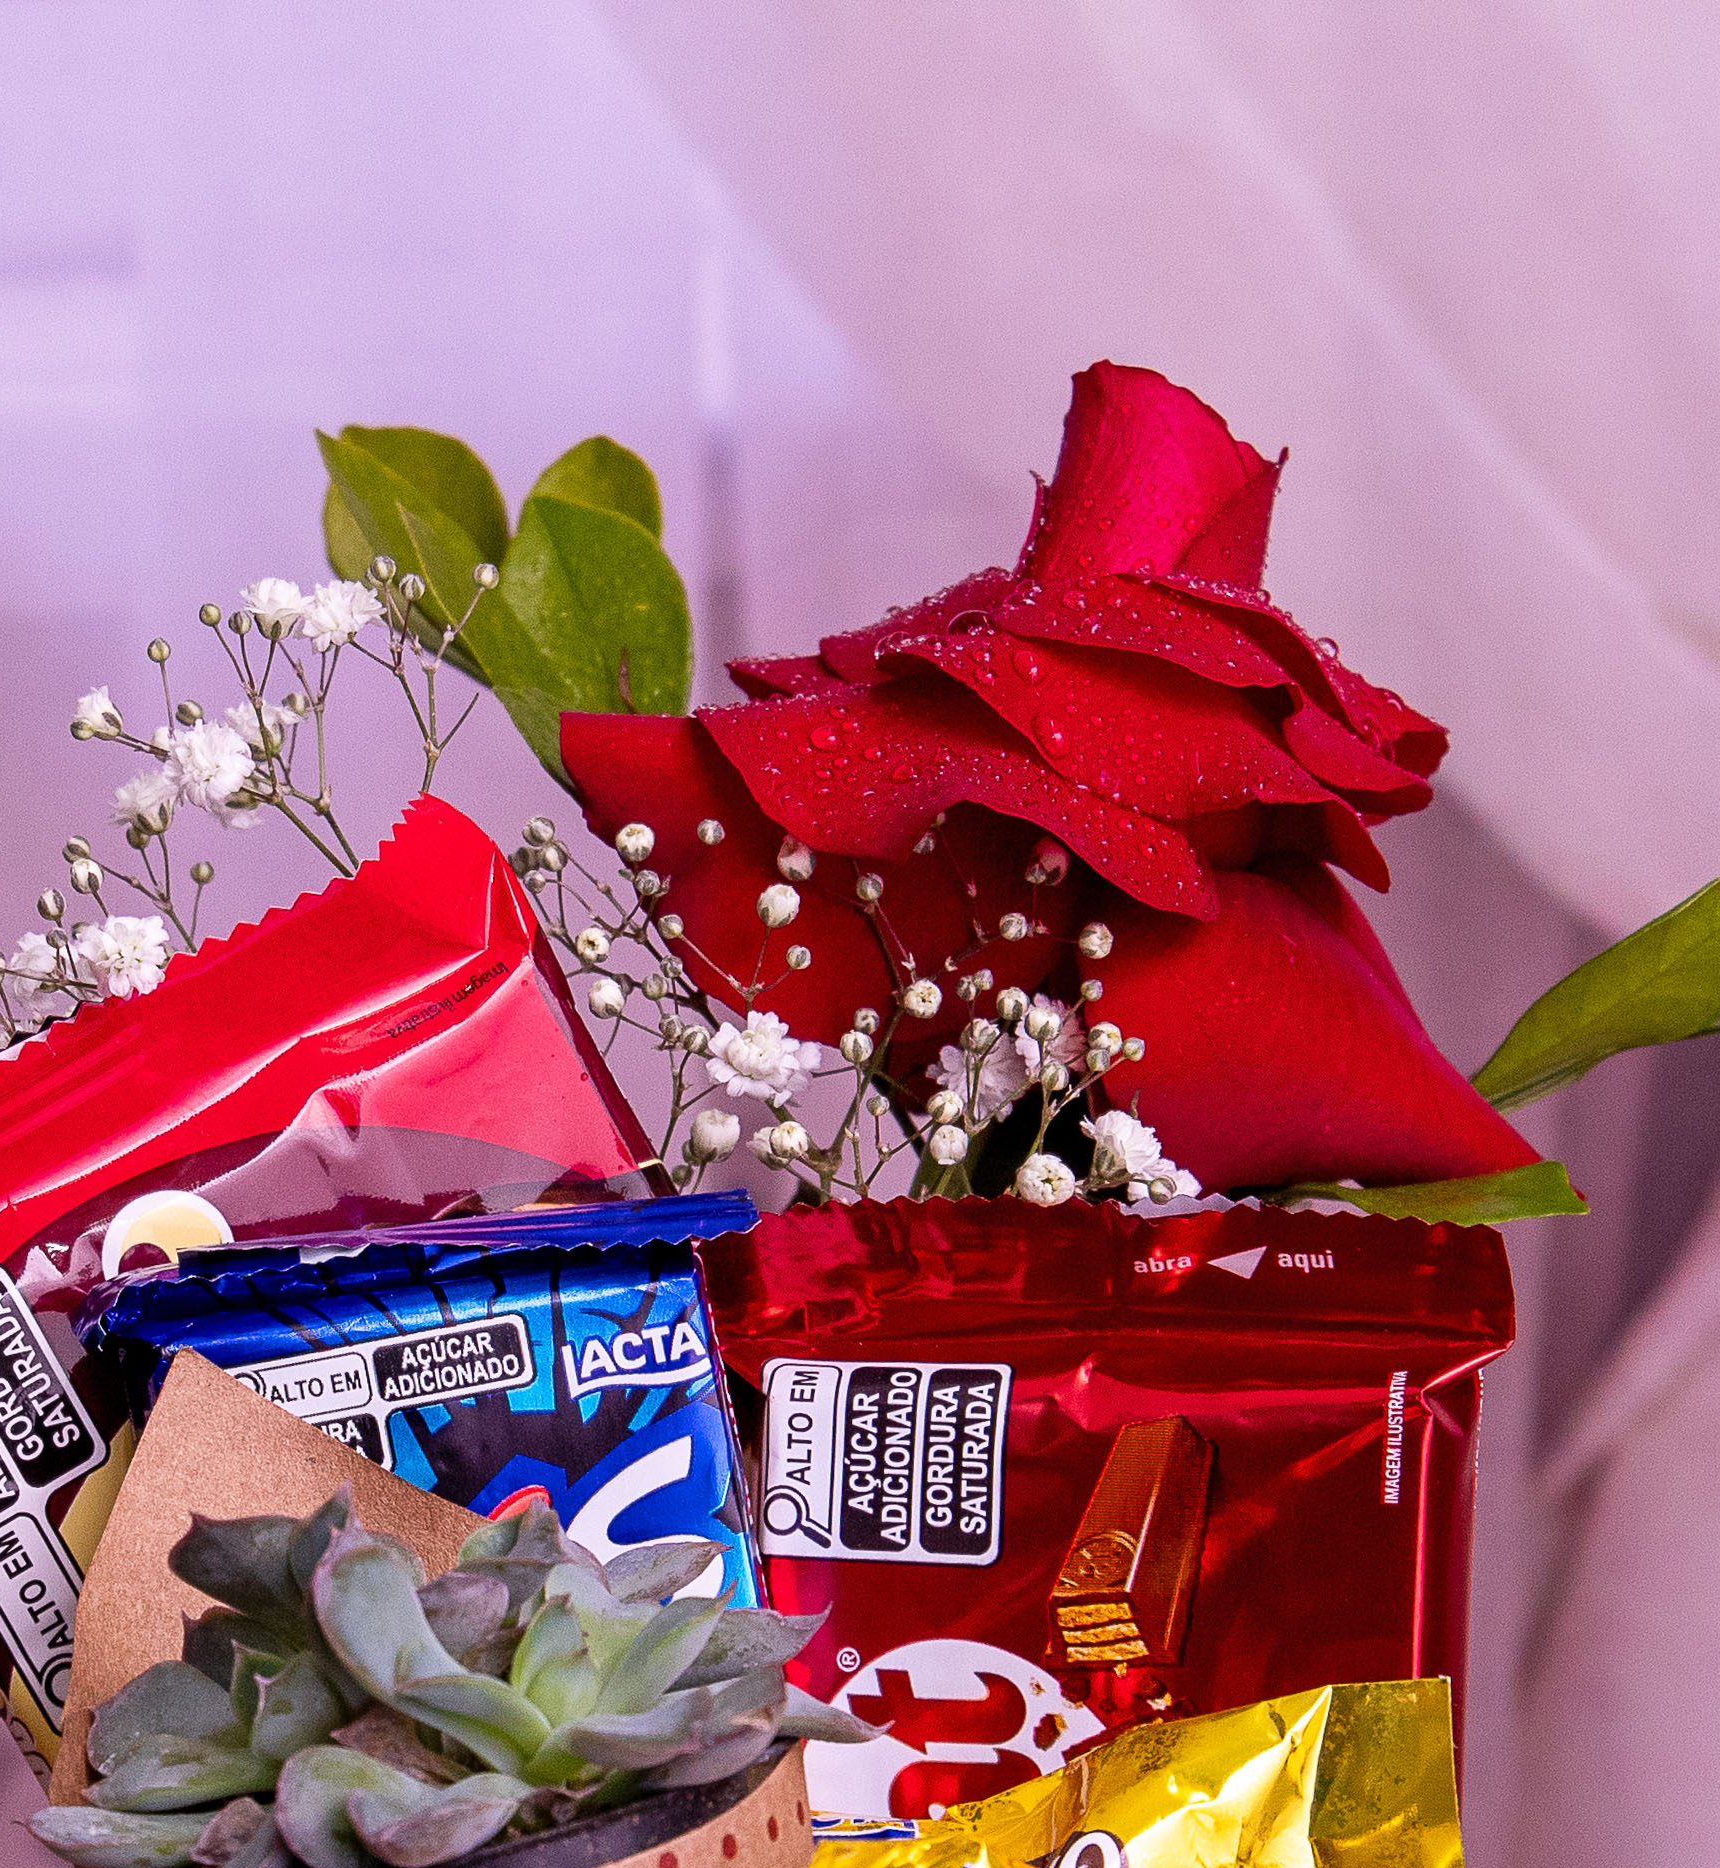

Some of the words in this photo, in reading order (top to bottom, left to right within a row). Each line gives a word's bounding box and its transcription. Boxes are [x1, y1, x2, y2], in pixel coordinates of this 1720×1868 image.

[1134, 1255, 1192, 1273] abra
[1278, 1250, 1335, 1273] aqui
[270, 1377, 324, 1404] ALTO
[332, 1370, 362, 1393] EM
[384, 1355, 520, 1399] ADICIONADO
[401, 1331, 493, 1371] AÇÚCAR
[562, 1322, 713, 1398] LACTA
[789, 1371, 820, 1403] EM
[1387, 1370, 1409, 1446] ILUSTRATIVA
[786, 1412, 813, 1486] ALTO
[844, 1392, 882, 1515] AÇÚCAR
[880, 1371, 918, 1545] ADICIONADO
[925, 1385, 961, 1527] GORDURA
[959, 1382, 996, 1535] SATURADA
[1384, 1448, 1402, 1504] IMAGEM
[19, 1579, 75, 1649] ALTO
